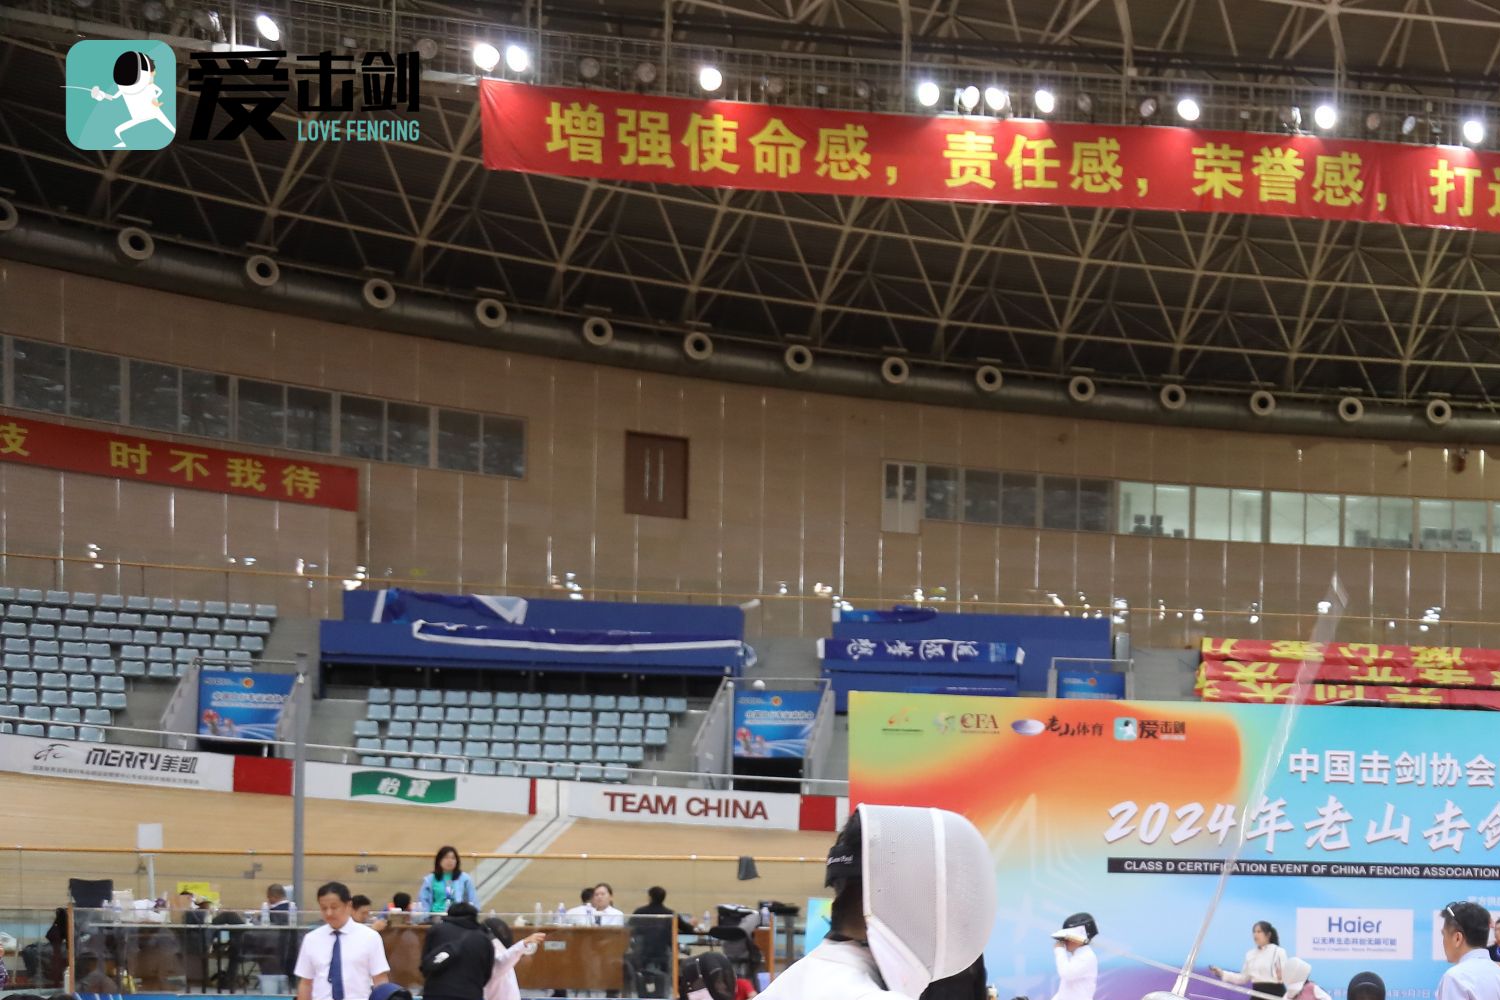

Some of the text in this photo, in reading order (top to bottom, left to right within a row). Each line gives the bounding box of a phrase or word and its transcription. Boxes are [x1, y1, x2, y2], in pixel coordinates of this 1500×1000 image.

[108, 440, 322, 500] 时不我待
[960, 712, 999, 730] CFA
[603, 791, 769, 820] TEAM CHINA
[1124, 860, 1161, 872] CLASS
[1166, 861, 1174, 873] D
[1270, 863, 1308, 876] EVENT
[1312, 864, 1327, 876] OF
[1331, 865, 1366, 877] CHINA
[1370, 865, 1420, 878] FENCING
[1423, 867, 1499, 880] ASSOCIATION
[1328, 917, 1382, 933] Haier
